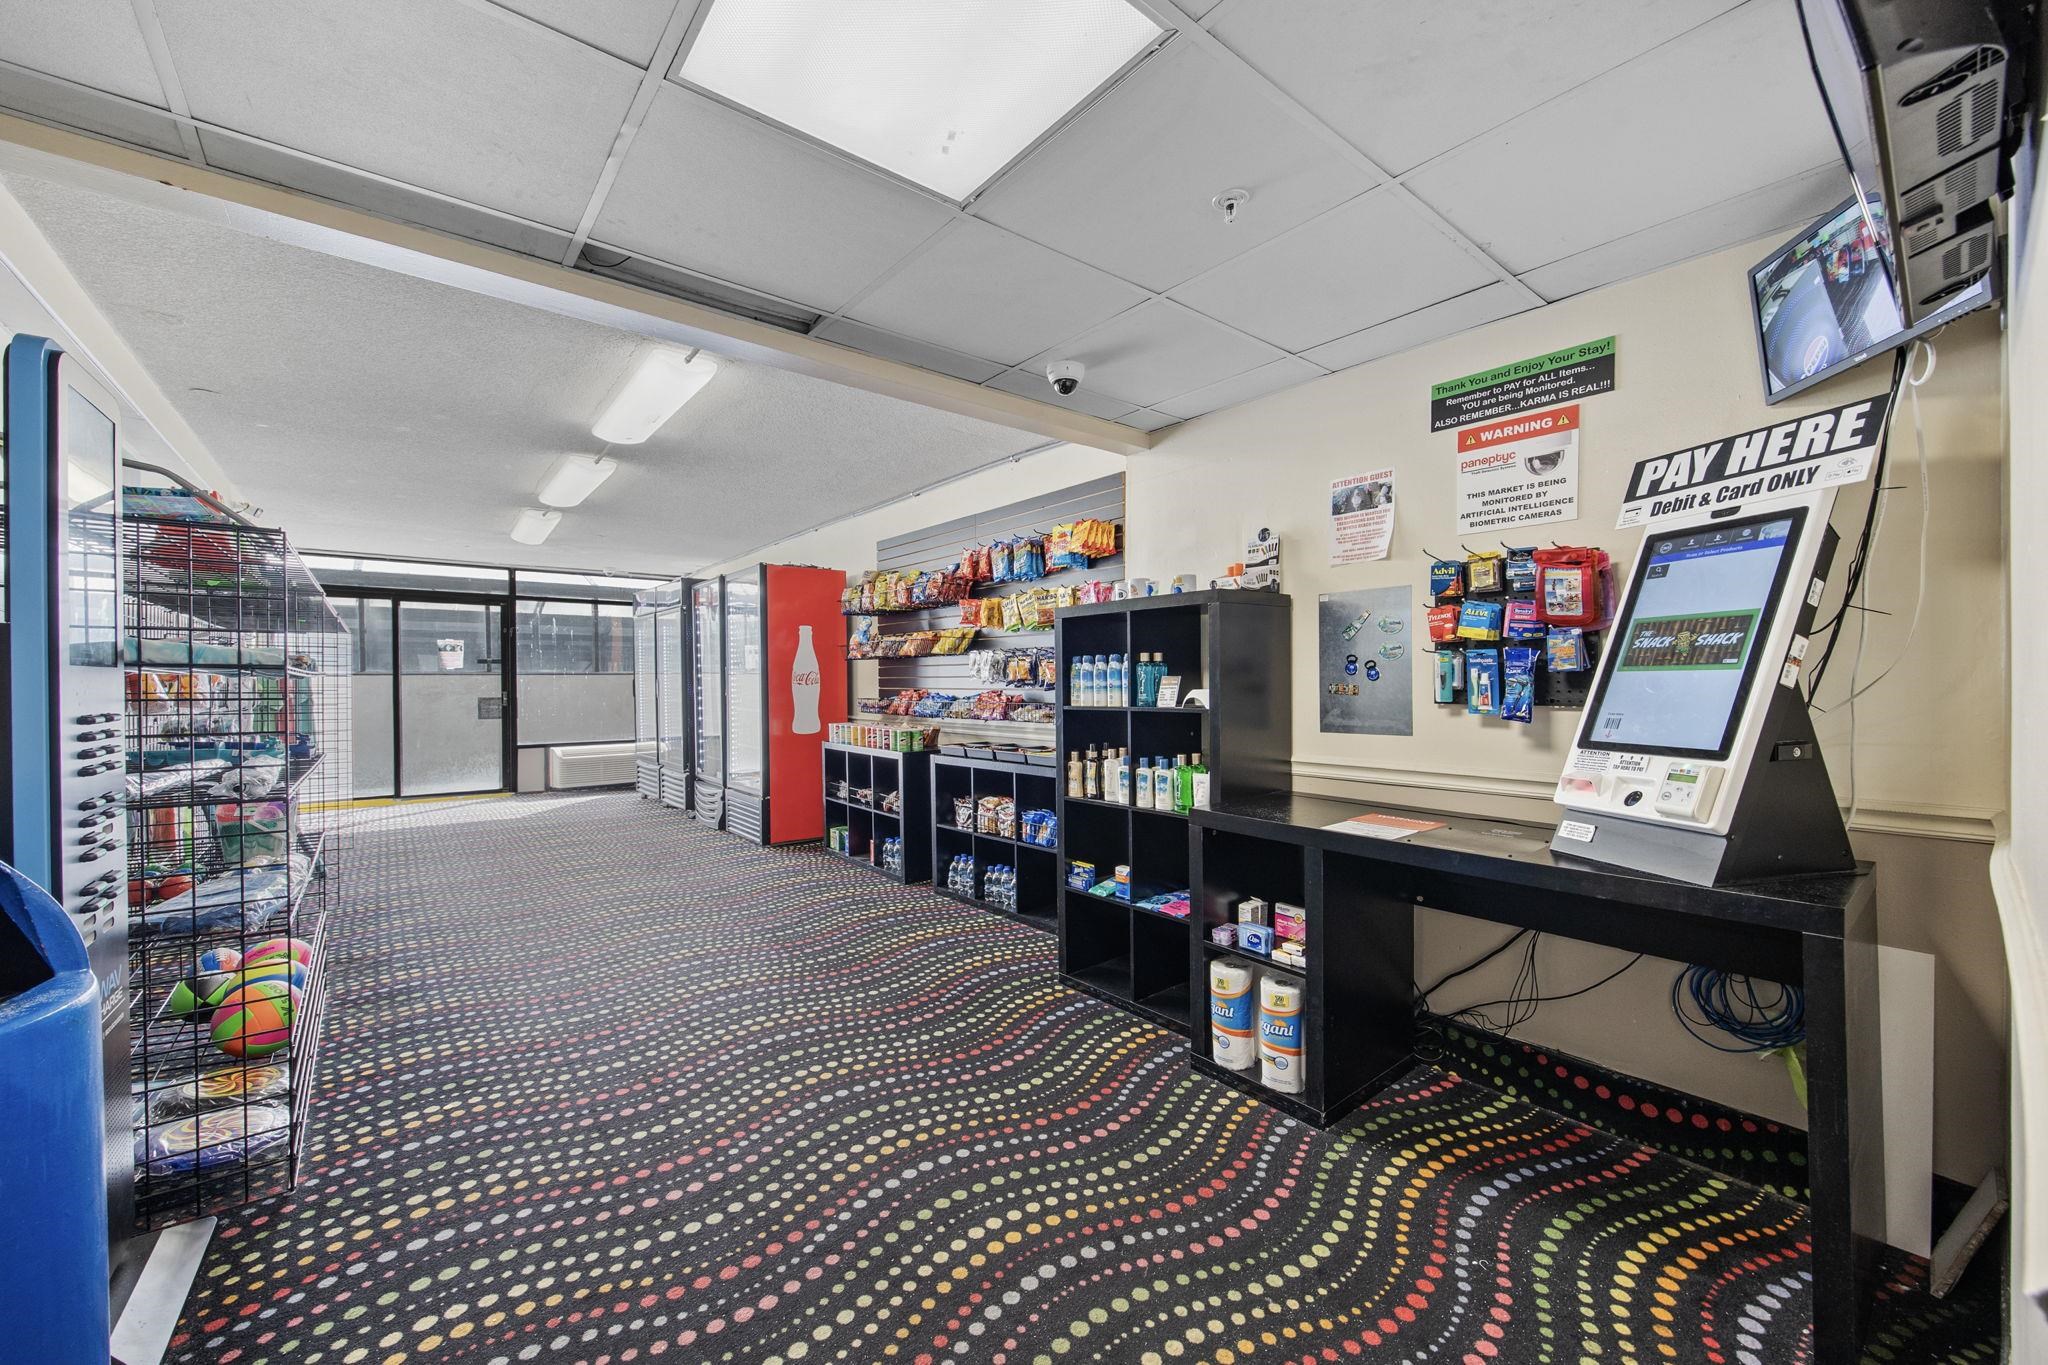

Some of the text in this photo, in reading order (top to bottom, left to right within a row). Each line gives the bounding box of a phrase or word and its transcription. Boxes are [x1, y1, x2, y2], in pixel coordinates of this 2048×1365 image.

[1436, 341, 1610, 396] Thank You and Enjoy Your Stay!
[1446, 365, 1595, 406] Remember to PAY for ALL Items...
[1462, 377, 1576, 410] YOU are being Monitored.
[1434, 417, 1457, 429] ALSO
[1558, 389, 1569, 398] IS
[1571, 379, 1611, 396] REAL!!!
[1480, 417, 1553, 442] WARNING
[1636, 402, 1872, 497] PAY HERE
[1461, 452, 1516, 471] panoptyc
[1332, 470, 1393, 489] ATTENTION GUEST
[1467, 478, 1567, 499] THIS MARKET IS BEING
[1482, 491, 1548, 506] MONITORED BY
[1650, 465, 1822, 518] Debit & Card ONLY
[1460, 496, 1574, 520] ARTIFICIAL INTELLIGENCE
[1469, 509, 1562, 528] BIOMETRIC CAMERAS
[1433, 567, 1455, 575] Advil
[1428, 612, 1452, 622] TYLENOL
[1465, 608, 1489, 617] ALEVE
[1632, 632, 1744, 649] SNACK SHACK
[1640, 630, 1655, 638] THE
[101, 986, 123, 1015] HARGE
